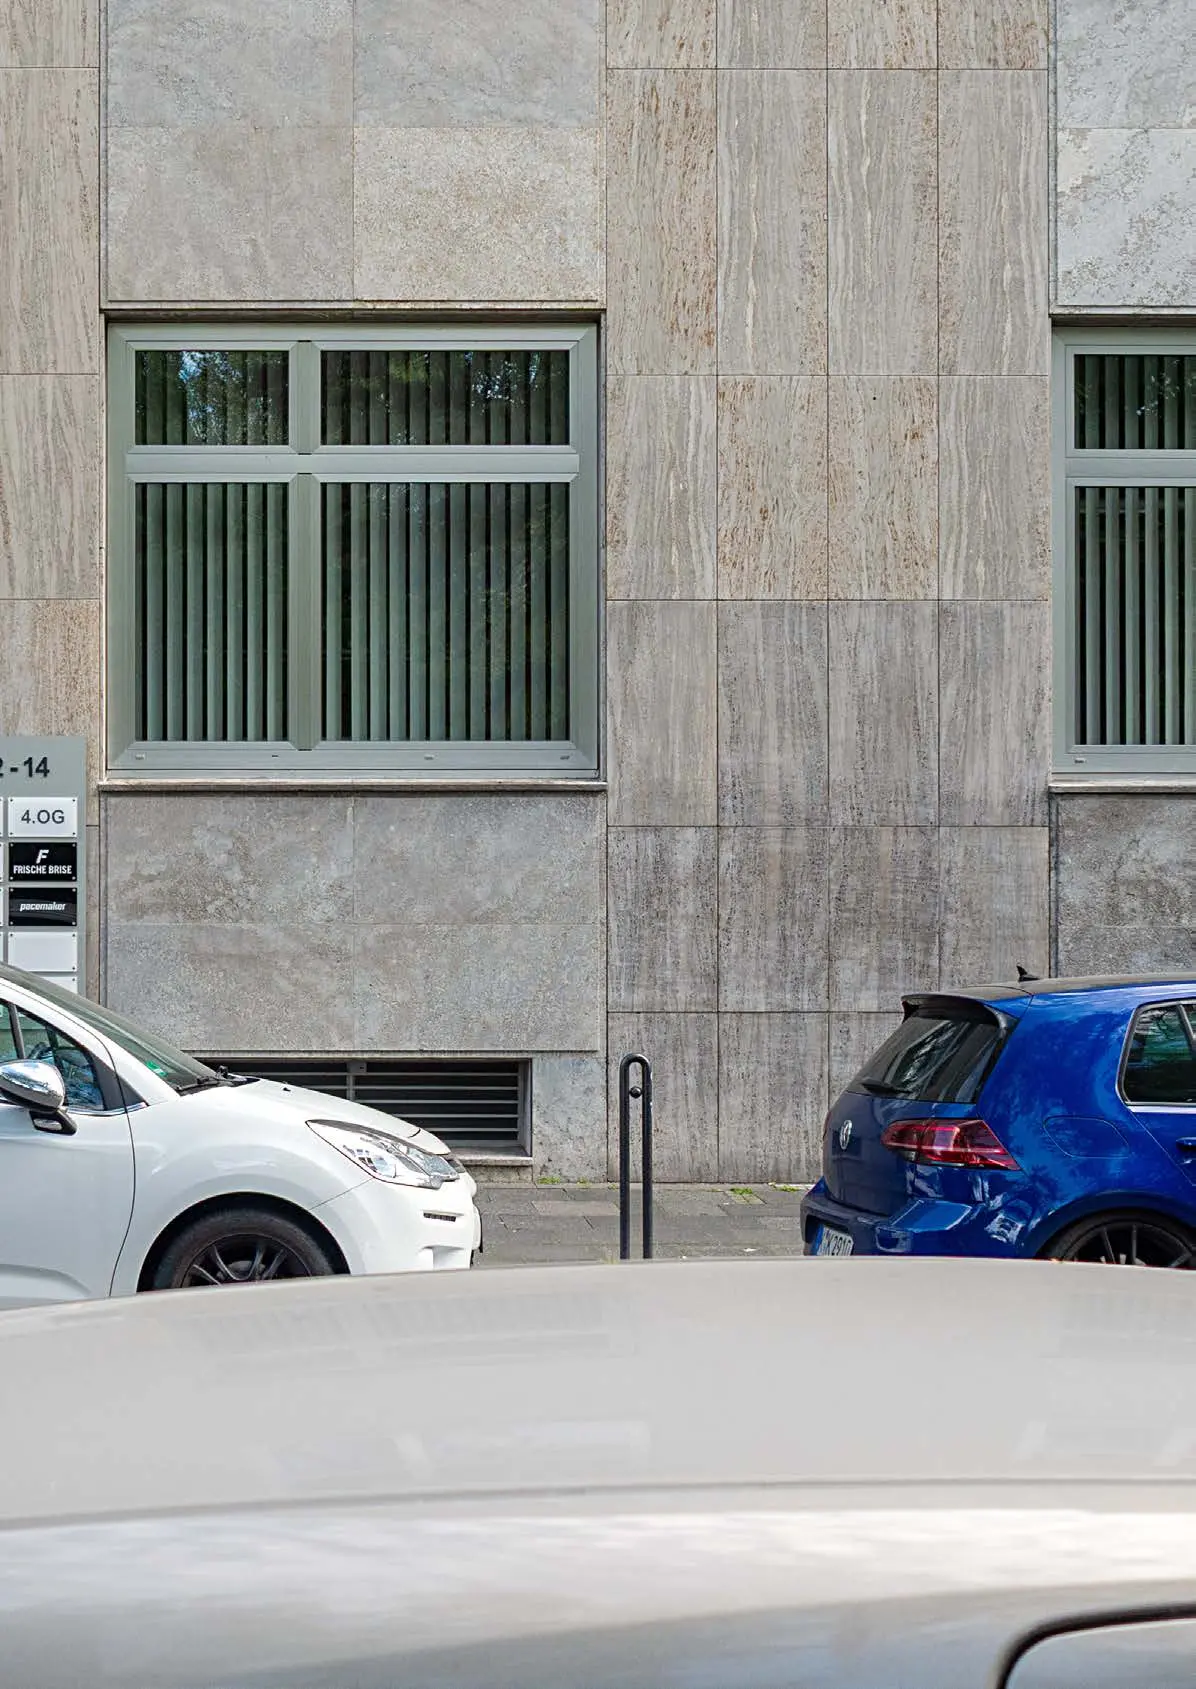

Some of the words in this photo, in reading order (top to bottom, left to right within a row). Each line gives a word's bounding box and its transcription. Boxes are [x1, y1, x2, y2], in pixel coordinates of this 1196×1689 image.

[21, 809, 65, 824] 4.OG
[36, 849, 49, 864] F
[13, 865, 47, 875] FRISCHE
[48, 865, 72, 875] BRISE
[20, 901, 66, 912] pacemaker
